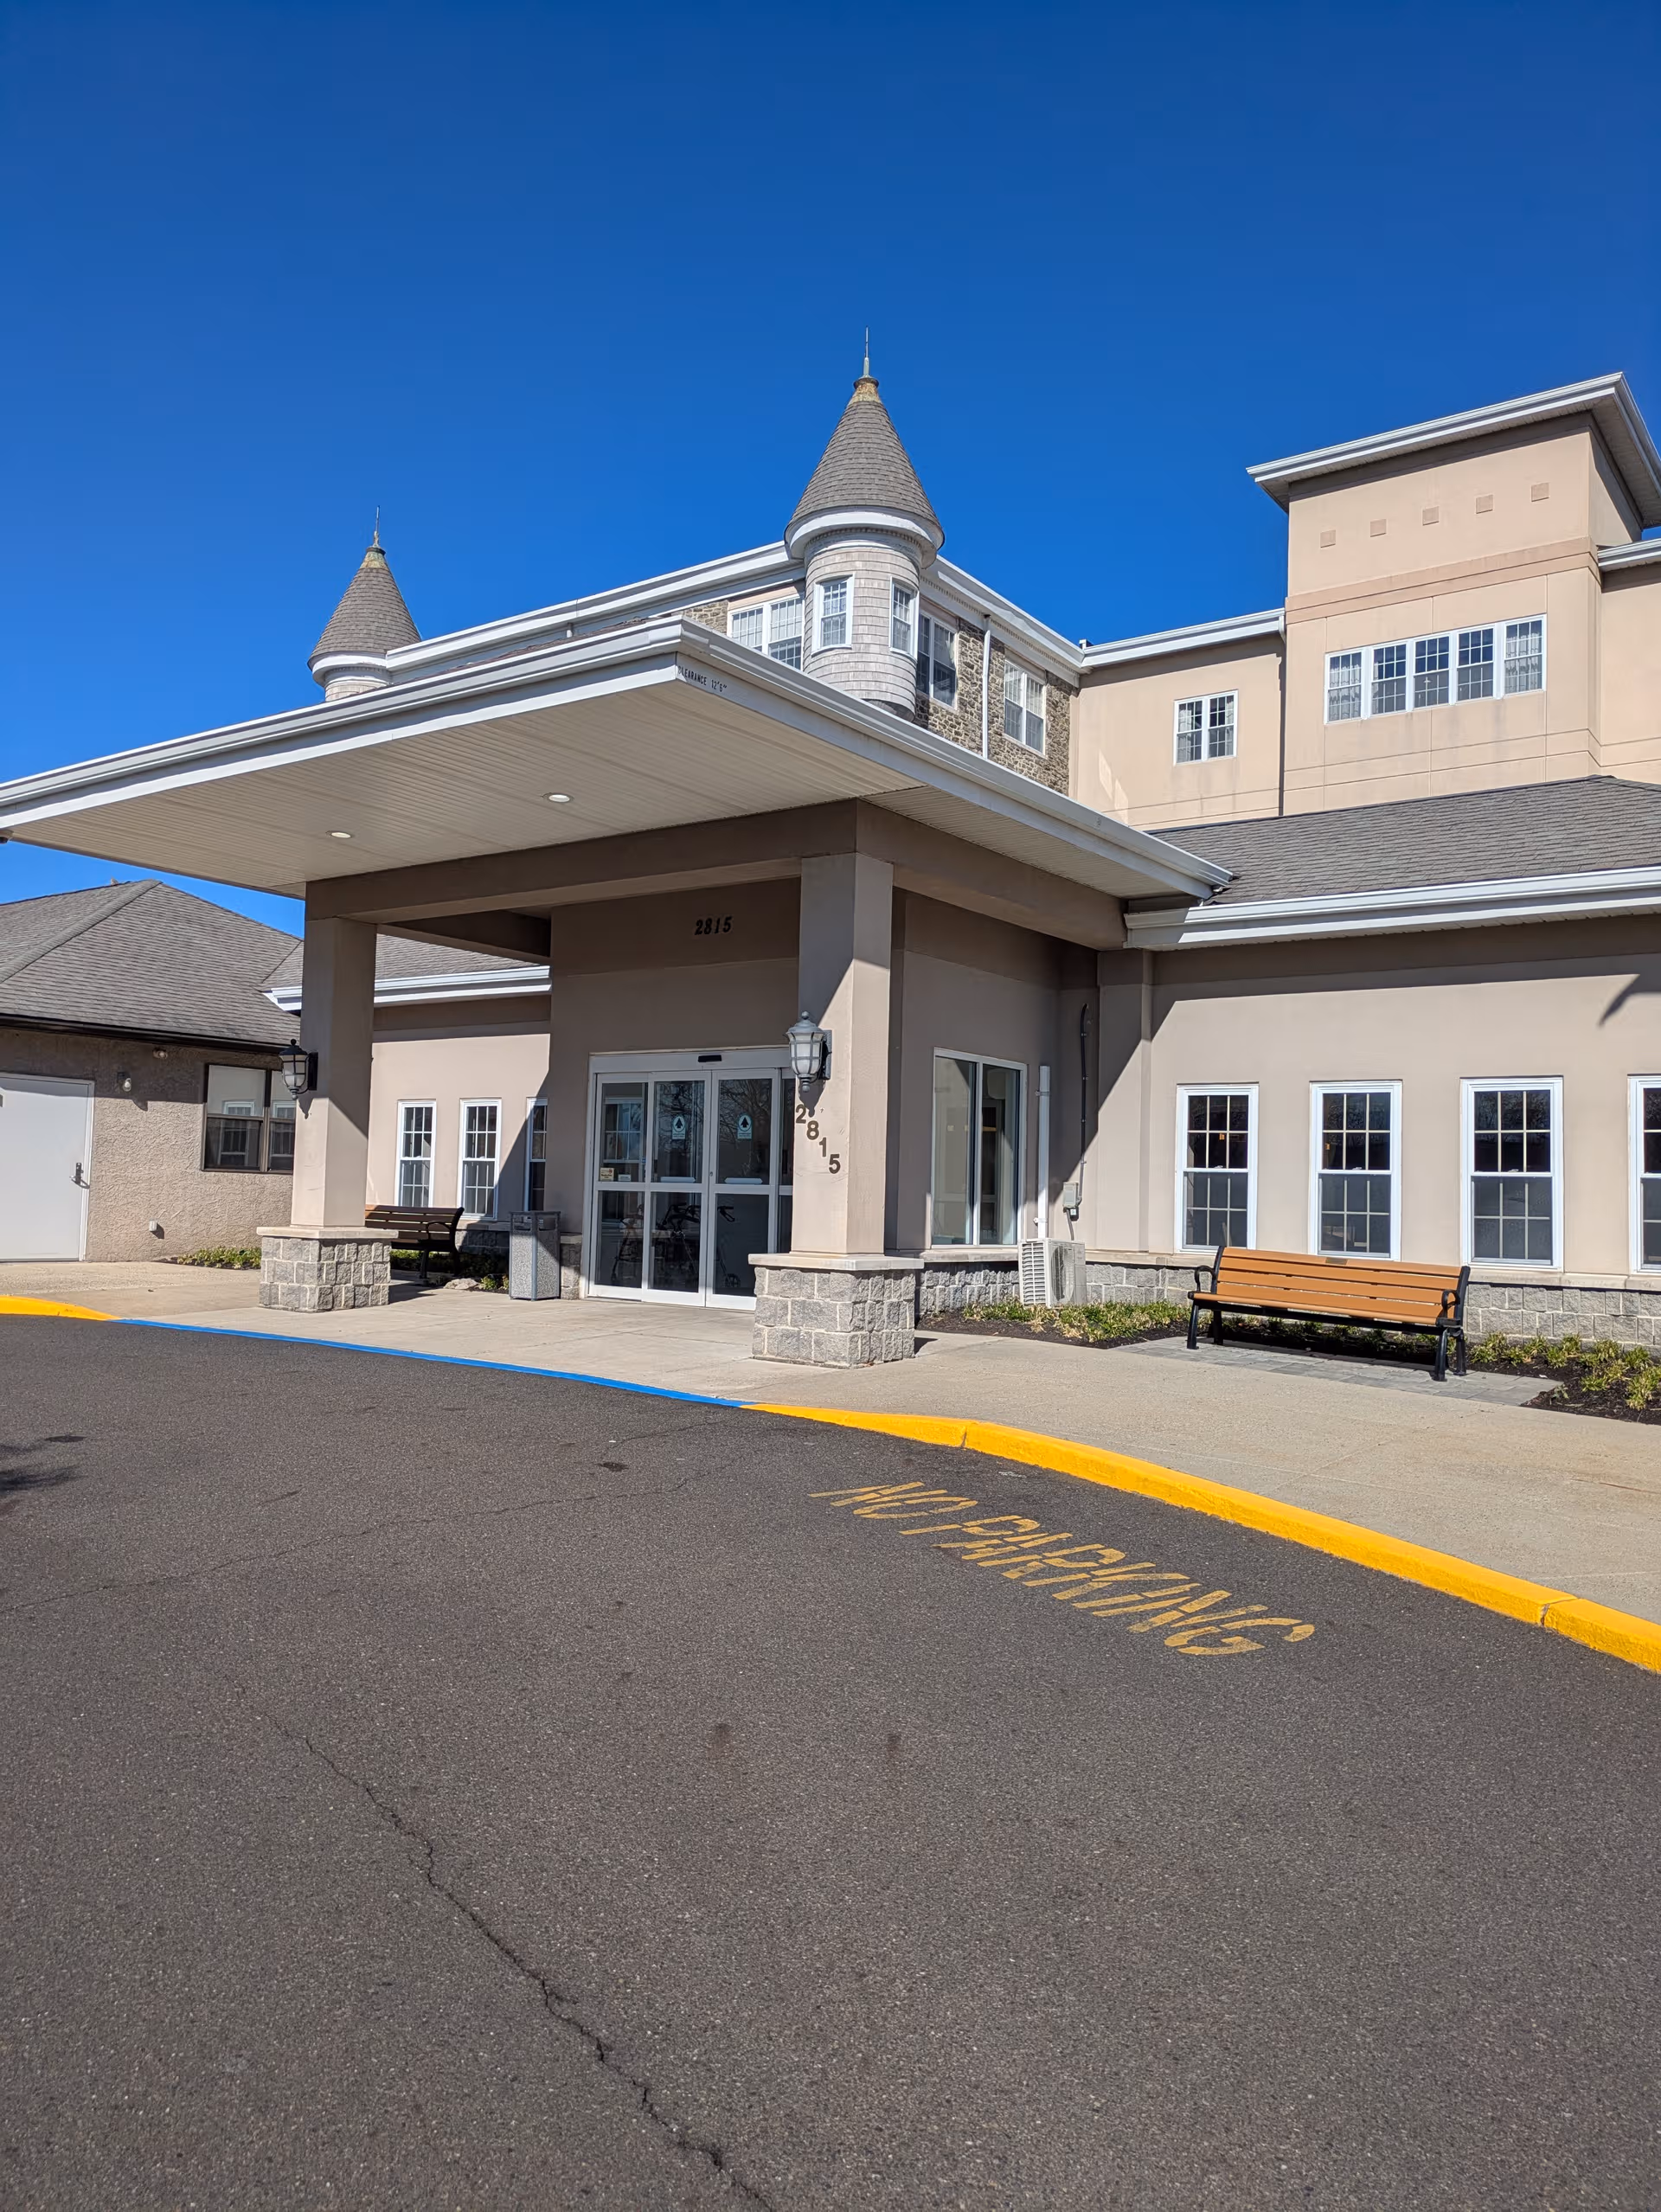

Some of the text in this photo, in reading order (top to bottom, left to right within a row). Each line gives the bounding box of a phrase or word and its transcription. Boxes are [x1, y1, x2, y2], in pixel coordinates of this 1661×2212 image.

[677, 665, 707, 686] CLEARANCE
[695, 916, 733, 936] 2815
[795, 1104, 841, 1175] 2815
[808, 1481, 1315, 1656] NO PARKING
